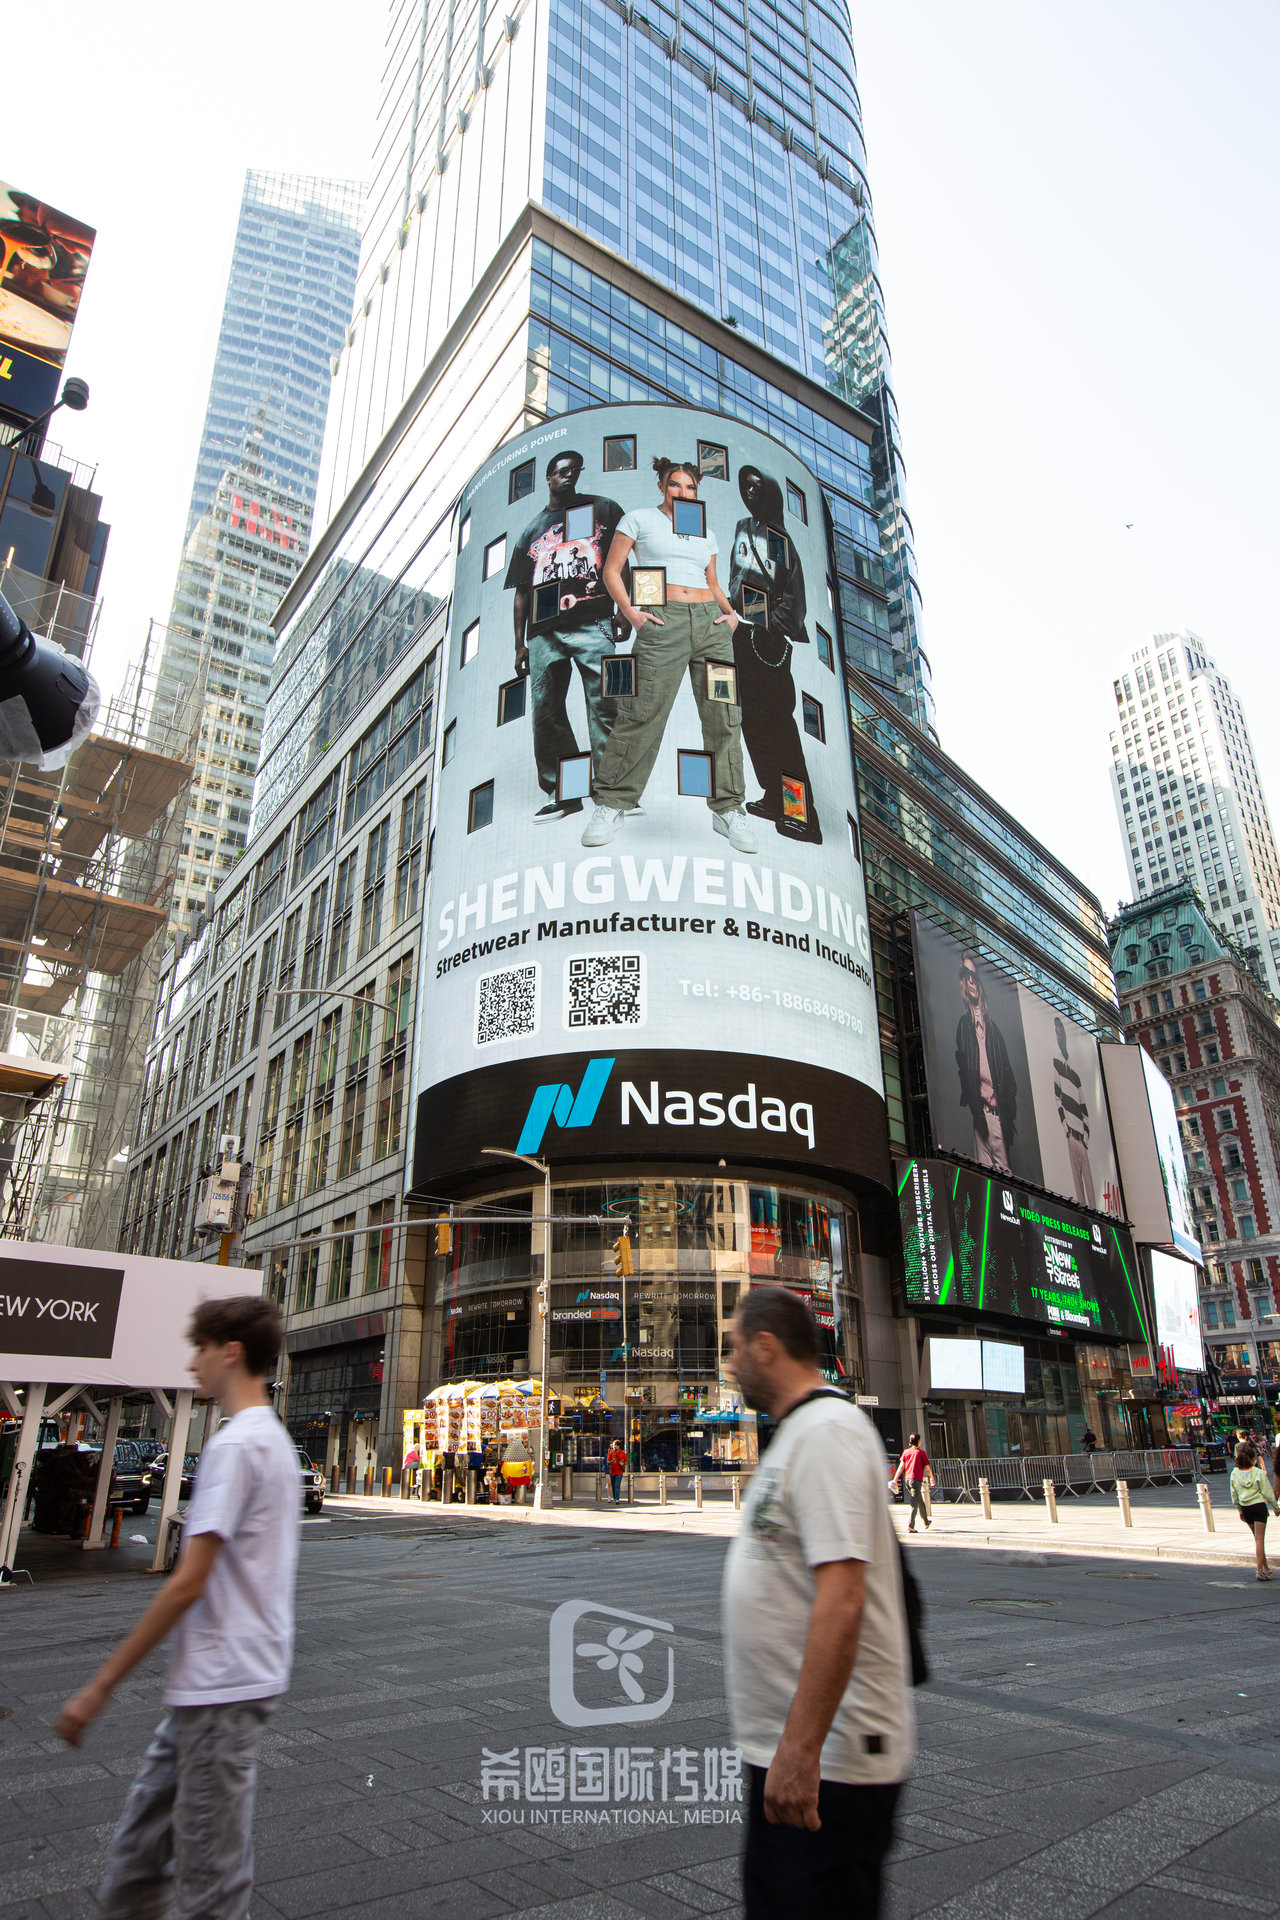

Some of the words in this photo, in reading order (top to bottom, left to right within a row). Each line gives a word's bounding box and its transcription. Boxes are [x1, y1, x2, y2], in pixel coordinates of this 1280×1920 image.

[530, 428, 568, 449] POWER
[437, 855, 870, 962] SHENGWENDING
[436, 928, 530, 979] Streetwear
[537, 912, 715, 942] Manufacturer
[723, 917, 739, 937] &
[747, 920, 810, 953] Brand
[815, 938, 872, 990] Incubator
[679, 979, 719, 998] Tel:
[621, 1081, 816, 1150] Nasdaq
[912, 1163, 921, 1215] SUBSCRIBERS
[922, 1169, 931, 1209] CHANNELS
[917, 1217, 926, 1254] YOUTUBE
[926, 1211, 934, 1242] DIGITAL
[1020, 1207, 1041, 1223] VIDEO
[1042, 1215, 1061, 1231] PRESS
[1061, 1221, 1090, 1241] RELEASES
[1051, 1245, 1071, 1269] New
[1053, 1266, 1080, 1289] Street
[34, 1297, 100, 1322] YORK
[467, 1302, 488, 1312] REWRITE
[490, 1298, 523, 1308] TOMORROW
[590, 1291, 620, 1301] Nasdaq
[634, 1292, 668, 1300] REWRITE
[673, 1292, 717, 1300] TOMORROW
[1030, 1286, 1038, 1299] 17
[1079, 1299, 1100, 1313] SHOWS
[631, 1347, 674, 1359] Nasdaq
